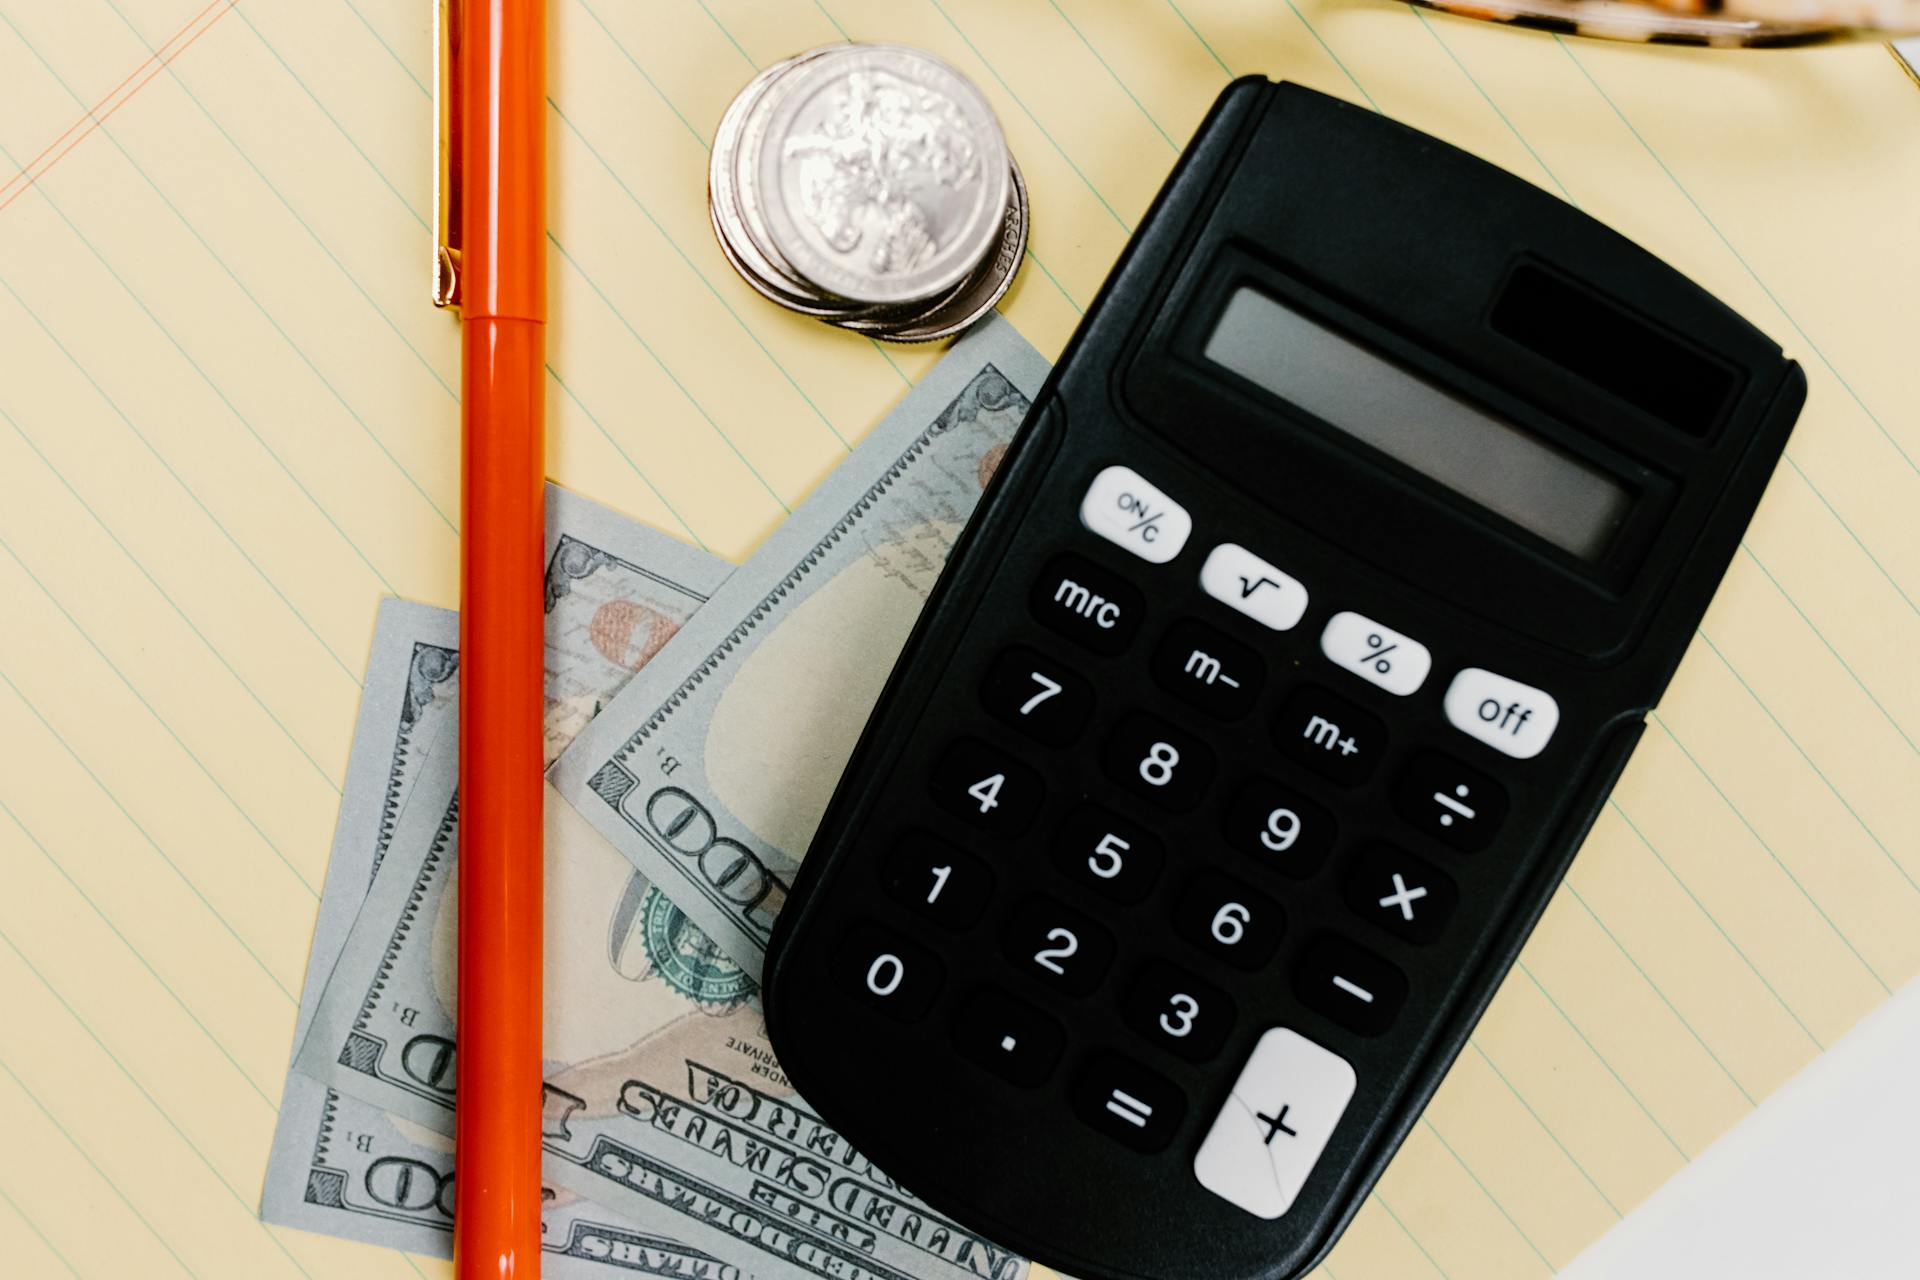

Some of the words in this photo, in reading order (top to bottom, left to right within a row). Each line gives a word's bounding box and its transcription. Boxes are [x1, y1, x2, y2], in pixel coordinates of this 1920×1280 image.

[995, 205, 1019, 273] ARCHES
[1054, 579, 1120, 628] mrc
[1020, 672, 1062, 715] 7
[1477, 698, 1534, 736] off
[1139, 742, 1179, 786] 8
[968, 773, 1005, 813] 4
[1260, 808, 1301, 851] 9
[1088, 833, 1130, 878] 5
[927, 866, 952, 903] 1
[1211, 902, 1250, 945] 6
[1034, 928, 1078, 975] 2
[866, 954, 904, 996] 0
[1159, 993, 1199, 1037] 3
[617, 1080, 832, 1199] STATES
[600, 1152, 793, 1255] DOLLARS
[750, 1179, 877, 1256] THE
